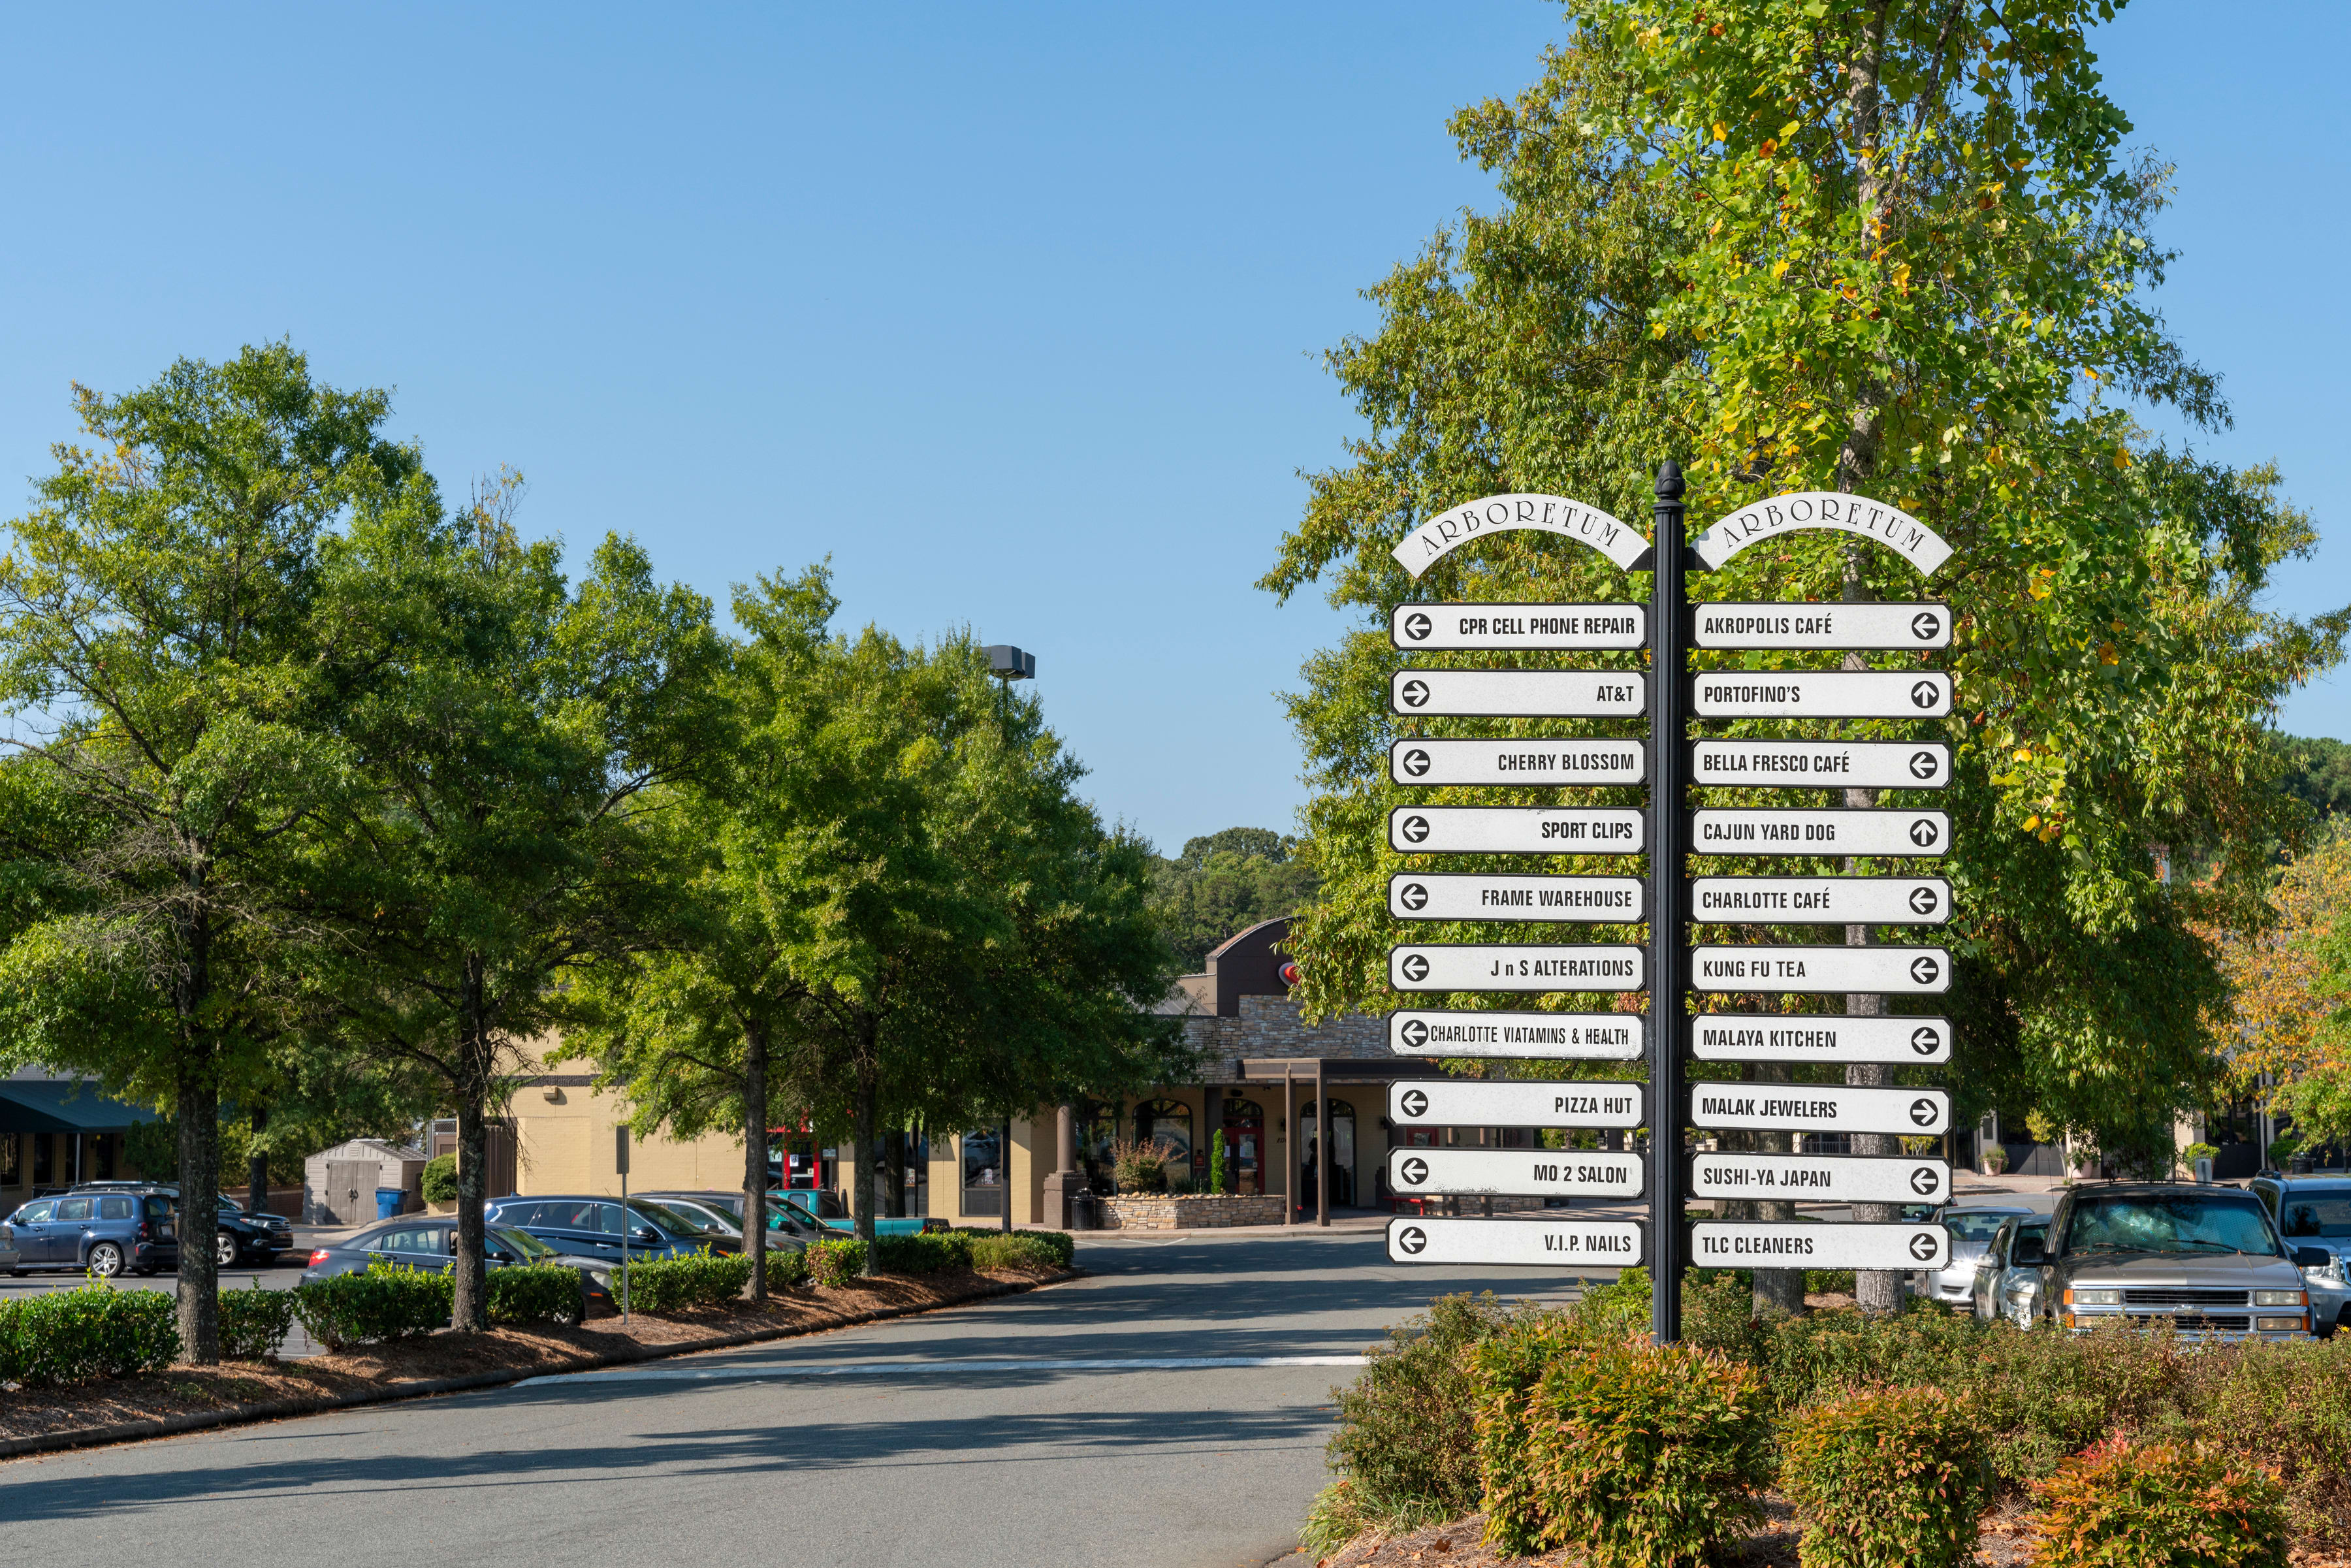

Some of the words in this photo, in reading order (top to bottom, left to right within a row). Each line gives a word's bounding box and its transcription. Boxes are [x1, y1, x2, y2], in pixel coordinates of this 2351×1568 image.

[1425, 500, 1621, 557] ARBORETUM
[1724, 499, 1926, 553] ARBORETUM
[1460, 618, 1487, 634] CPR
[1493, 618, 1525, 634] CELL
[1531, 618, 1578, 634] PHONE
[1585, 618, 1634, 633] REPAIR
[1705, 618, 1789, 633] AKROPOLIS
[1796, 613, 1831, 633] CAFÉ
[1597, 686, 1633, 701] AT&T
[1499, 755, 1556, 770] CHERRY
[1563, 754, 1633, 769] BLOSSOM
[1704, 755, 1747, 771] BELLA
[1753, 756, 1808, 771] FRESCO
[1814, 751, 1849, 772] CAFÉ
[1542, 822, 1587, 838] SPORT
[1593, 823, 1632, 839] CLIPS
[1704, 824, 1754, 840] CAJUN
[1761, 824, 1799, 840] YARD
[1806, 825, 1834, 840] DOG
[1482, 890, 1532, 905] FRAME
[1539, 891, 1631, 906] WAREHOUSE
[1703, 892, 1787, 908] CHARLOTTE
[1794, 888, 1829, 908] CAFÉ
[1491, 961, 1498, 976] J
[1506, 965, 1513, 976] n
[1520, 960, 1527, 976] S
[1534, 960, 1633, 976] ALTERATIONS
[1704, 961, 1744, 977] KUNG
[1752, 961, 1769, 977] FU
[1777, 962, 1805, 976] TEA
[1431, 1026, 1497, 1042] CHARLOTTE
[1504, 1027, 1565, 1044] VIATAMINS
[1572, 1029, 1579, 1044] &
[1586, 1029, 1627, 1044] HEALTH
[1704, 1030, 1764, 1046] MALAYA
[1770, 1031, 1836, 1047] KITCHEN
[1556, 1097, 1597, 1113] PIZZA
[1605, 1098, 1632, 1113] HUT
[1703, 1098, 1755, 1115] MALAK
[1760, 1100, 1836, 1118] JEWELERS
[1535, 1165, 1557, 1181] MO
[1564, 1166, 1571, 1181] 2
[1578, 1166, 1626, 1183] SALON
[1704, 1168, 1774, 1185] SUSHI-YA
[1780, 1170, 1830, 1187] JAPAN
[1545, 1235, 1579, 1251] V.I.P.
[1586, 1236, 1630, 1251] NAILS
[1703, 1238, 1728, 1253] TLC
[1735, 1238, 1813, 1254] CLEANERS
